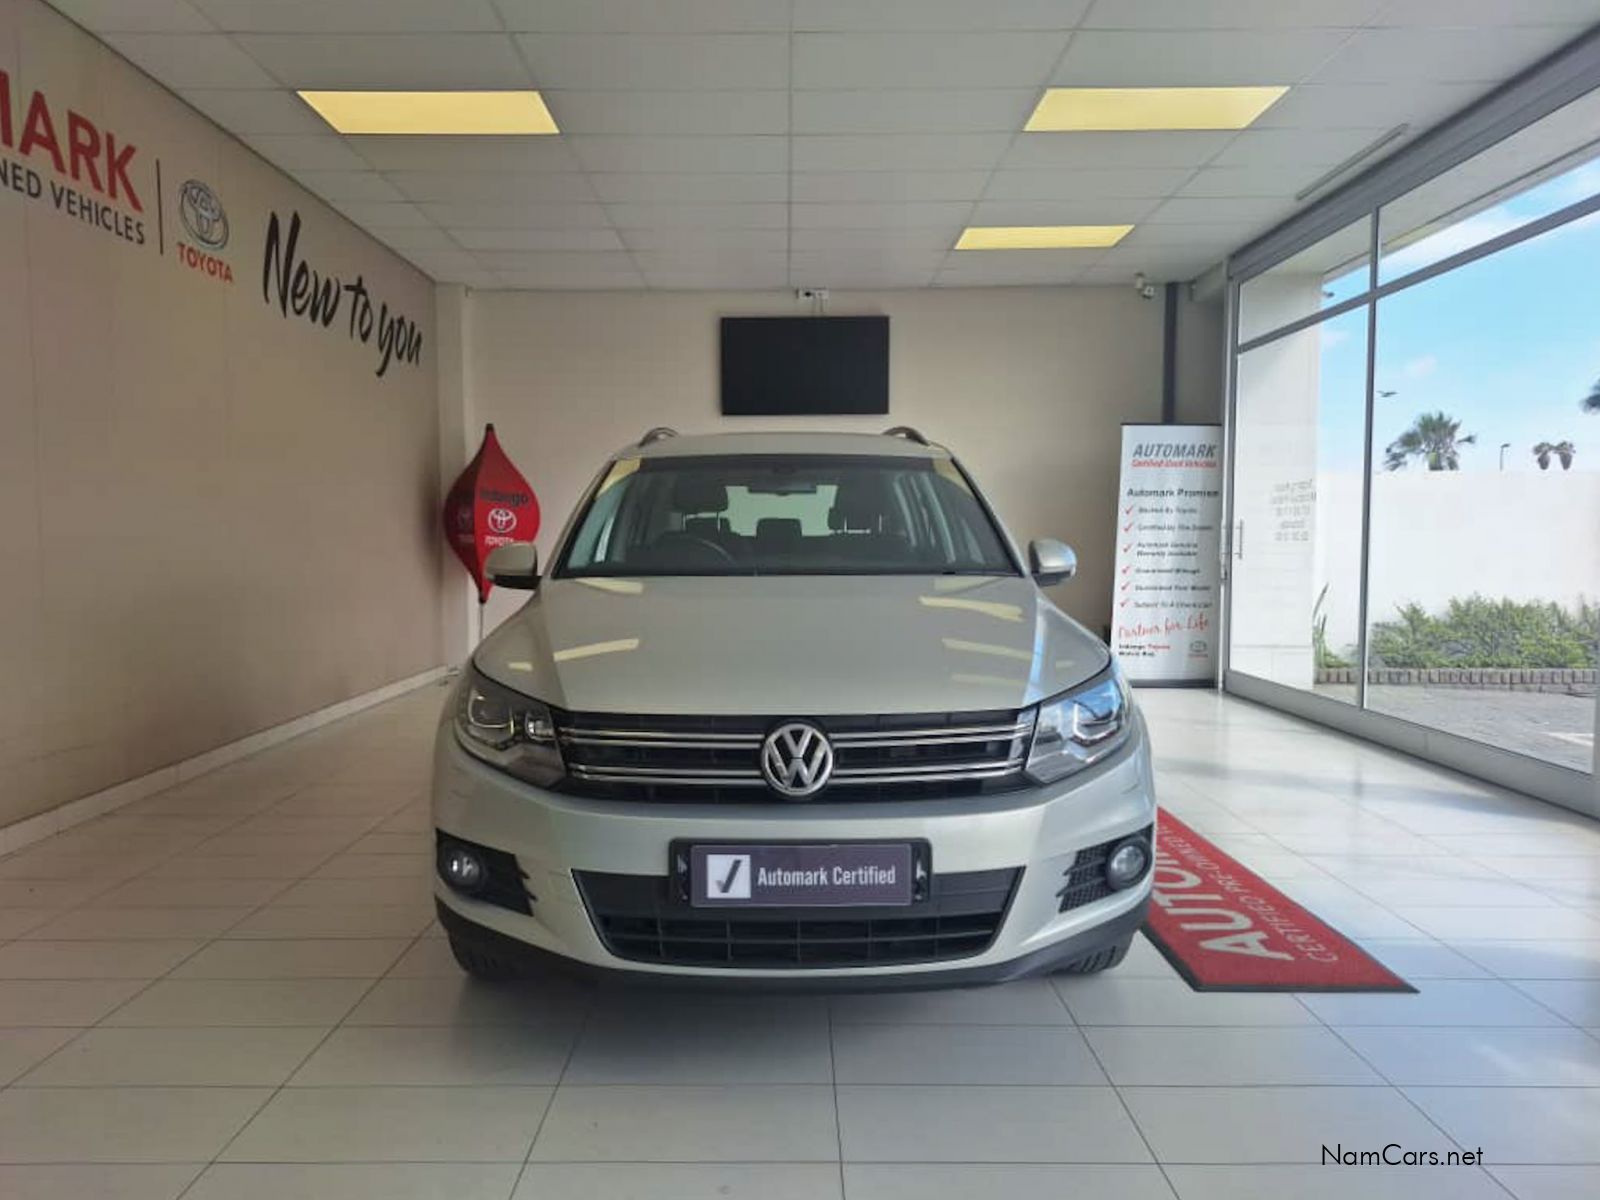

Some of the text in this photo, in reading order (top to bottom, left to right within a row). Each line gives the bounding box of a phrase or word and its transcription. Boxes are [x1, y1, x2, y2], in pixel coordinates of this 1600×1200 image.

[50, 180, 145, 245] VEHICLES
[177, 242, 234, 284] TOYOTA
[262, 211, 422, 377] New to you
[1132, 443, 1217, 458] AUTOMARK
[757, 865, 896, 886] Automark Certified
[1152, 846, 1294, 961] AUTO
[1239, 894, 1339, 963] CERTIFIED
